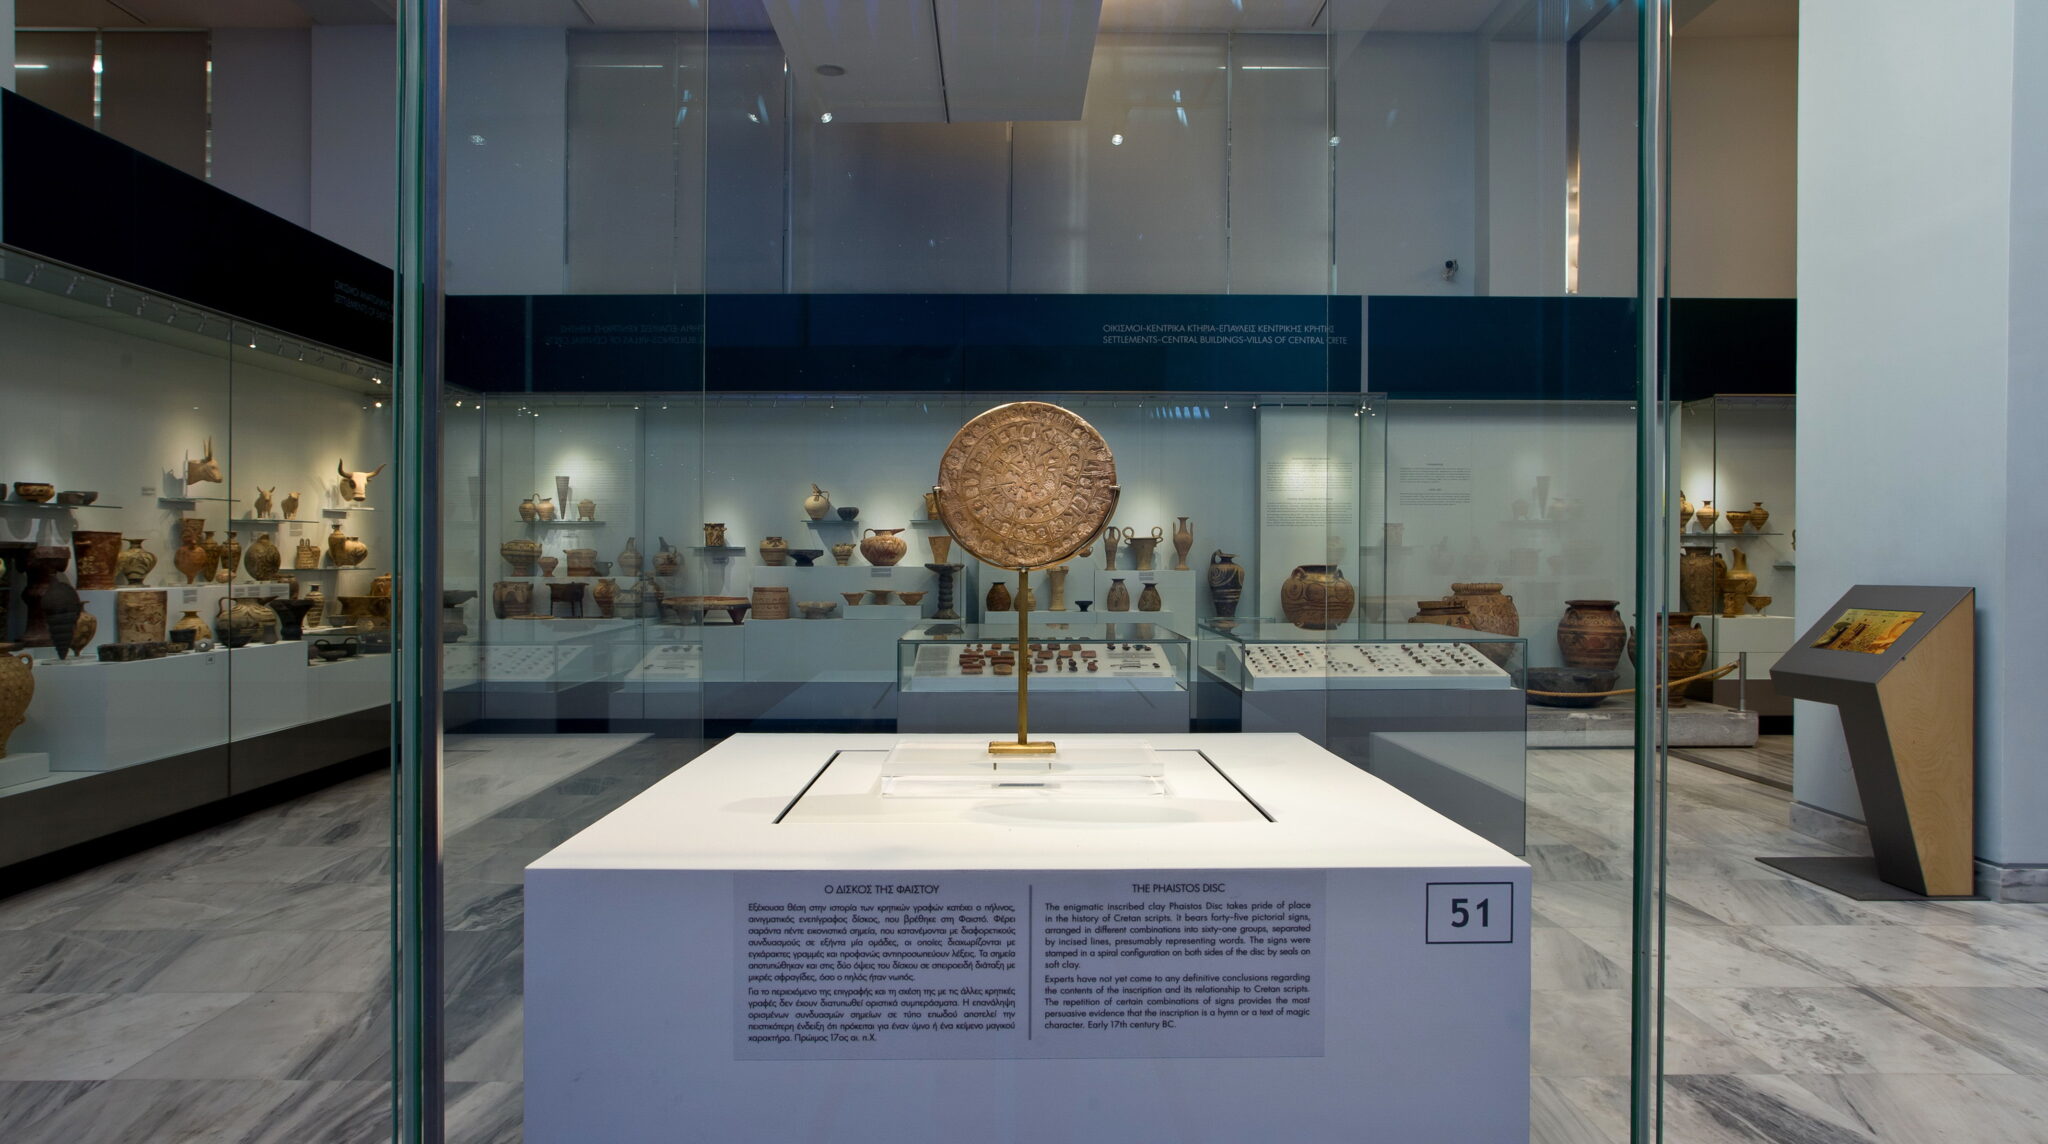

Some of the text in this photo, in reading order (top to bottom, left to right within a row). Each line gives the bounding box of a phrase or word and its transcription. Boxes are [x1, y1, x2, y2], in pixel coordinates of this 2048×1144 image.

[1187, 324, 1256, 333] ΚΤΗΡΙΑ-ΕΠΑΥΛΕΙΣ
[1258, 324, 1301, 333] ΚΕΝΤΡΙΚΗΣ
[1102, 335, 1197, 344] SETTLEMENTS-CENTRAL
[1199, 335, 1272, 344] BUILDINGS-VILLAS
[1274, 335, 1286, 344] OF
[1288, 335, 1325, 344] CENTRAL
[1131, 883, 1226, 893] THE PHAISTOS DISC
[1044, 902, 1060, 911] The
[1063, 903, 1104, 913] enigmatic
[1107, 901, 1145, 911] inscribed
[1147, 901, 1167, 913] clay
[1168, 901, 1203, 911] Phaistos
[1205, 901, 1223, 910] Disc
[1226, 901, 1248, 910] takes
[1251, 901, 1274, 912] pride
[1287, 901, 1312, 912] place
[1451, 898, 1489, 928] 51
[1055, 913, 1069, 923] the
[1071, 913, 1100, 925] history
[1113, 914, 1142, 922] Cretan
[1144, 914, 1173, 924] scripts.
[1184, 912, 1209, 922] bears
[1210, 912, 1249, 924] forty-five
[1251, 912, 1286, 923] pictorial
[1288, 913, 1311, 923] signs,
[1044, 925, 1082, 936] arranged
[1094, 925, 1127, 934] different
[1129, 925, 1182, 934] combinations
[1184, 925, 1199, 933] into
[1201, 925, 1238, 935] sixty-one
[1239, 926, 1269, 935] groups,
[1271, 924, 1312, 935] separated
[1044, 936, 1312, 948] by incised lines, presumably representing words. The signs were
[1044, 948, 1079, 959] stamped
[1096, 948, 1119, 959] spiral
[1120, 948, 1171, 959] configuration
[1184, 947, 1203, 957] both
[1203, 947, 1224, 956] sides
[1235, 947, 1248, 956] the
[1249, 947, 1266, 956] disc
[1279, 947, 1299, 956] seals
[1044, 961, 1081, 971] soft clay.
[1044, 974, 1075, 985] Experts
[1076, 974, 1097, 983] have
[1099, 975, 1113, 983] not
[1114, 975, 1128, 985] yet
[1164, 976, 1181, 984] any
[1182, 973, 1221, 982] definitive
[1221, 973, 1270, 982] conclusions
[1270, 973, 1311, 984] regarding
[1044, 985, 1058, 995] the
[1059, 987, 1093, 995] contents
[1105, 985, 1120, 994] the
[1122, 986, 1163, 996] inscription
[1164, 985, 1182, 994] and
[1194, 985, 1241, 996] relationship
[1253, 984, 1281, 993] Cretan
[1283, 985, 1310, 995] scripts.
[1044, 997, 1060, 1006] The
[1062, 998, 1101, 1008] repetition
[1115, 998, 1144, 1008] certain
[1146, 996, 1200, 1006] combinations
[1214, 997, 1235, 1007] signs
[1237, 996, 1272, 1007] provides
[1275, 996, 1289, 1007] the
[1044, 1010, 1087, 1020] persuasive
[1088, 1008, 1126, 1018] evidence
[1126, 1008, 1143, 1017] that
[1144, 1008, 1158, 1017] the
[1159, 1009, 1200, 1019] inscription
[1217, 1007, 1239, 1018] hymn
[1259, 1008, 1274, 1016] text
[1285, 1008, 1311, 1018] magic
[1044, 1020, 1177, 1031] character. Early 17th century BC.
